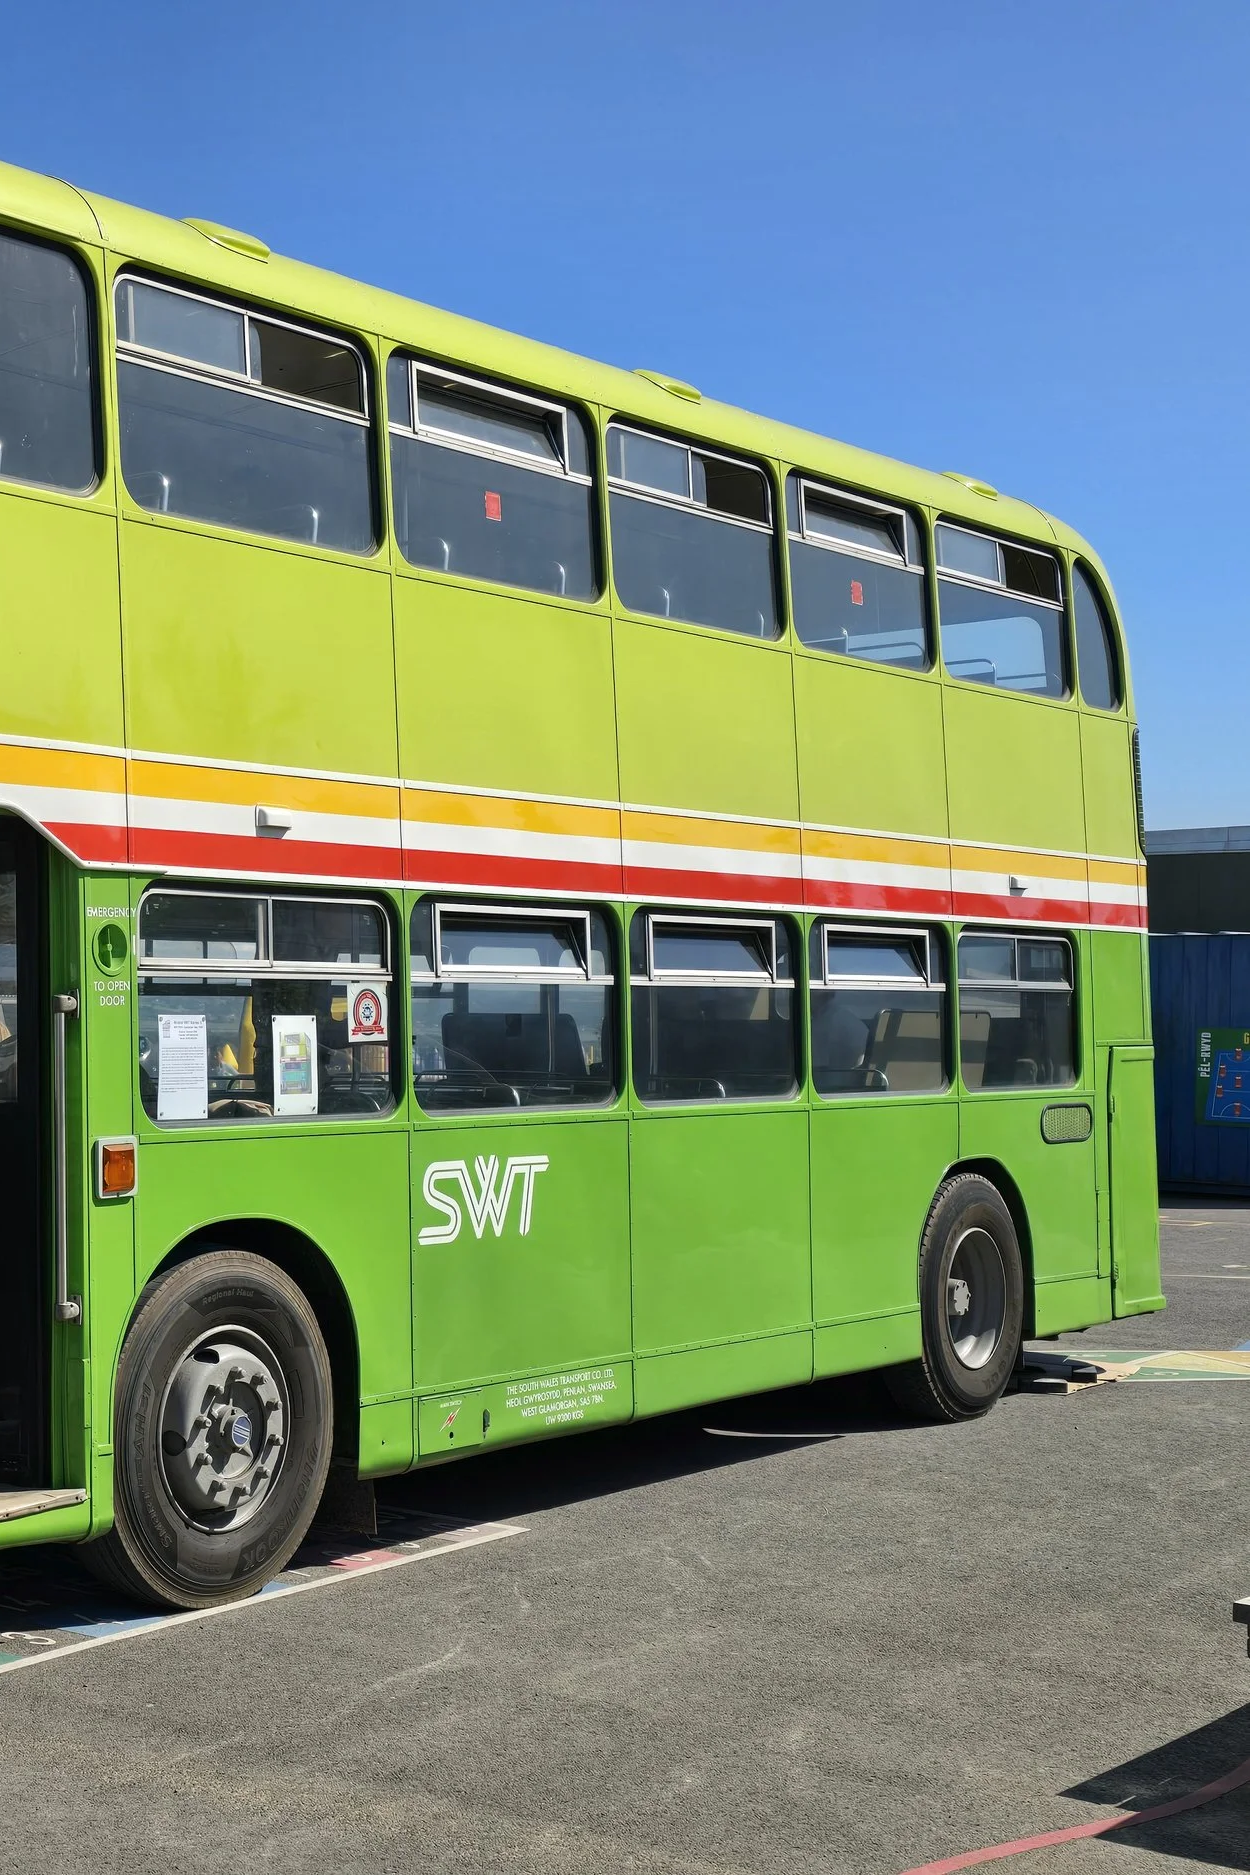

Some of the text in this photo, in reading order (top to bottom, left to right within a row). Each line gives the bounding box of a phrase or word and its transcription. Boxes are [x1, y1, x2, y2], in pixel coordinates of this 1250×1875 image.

[87, 907, 136, 918] EMERGENCY
[94, 981, 130, 991] TO OPEN
[100, 995, 125, 1006] DOOR
[1198, 1032, 1211, 1078] PÊL-RWYD
[418, 1154, 549, 1245] SWT
[507, 1386, 517, 1395] THE
[519, 1382, 539, 1393] SOUTH
[540, 1377, 559, 1388] WALES
[560, 1371, 591, 1385] TRANSPORT
[521, 1407, 537, 1417] WEST
